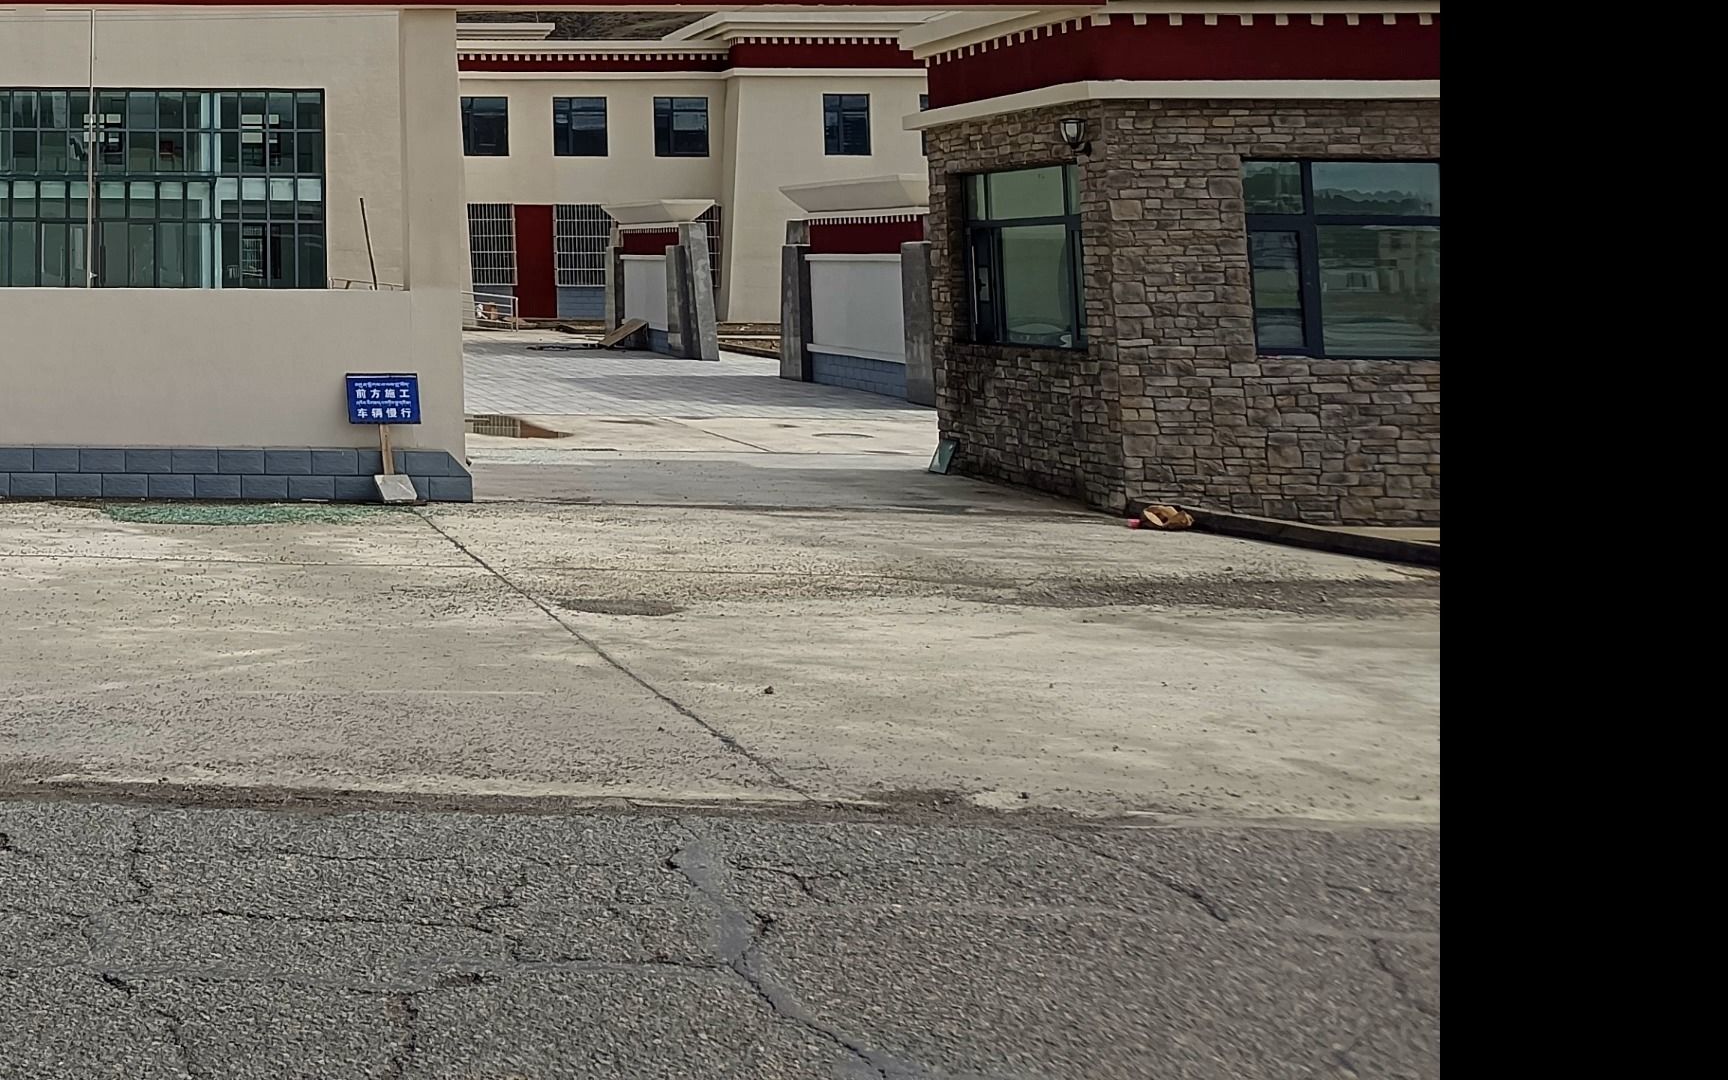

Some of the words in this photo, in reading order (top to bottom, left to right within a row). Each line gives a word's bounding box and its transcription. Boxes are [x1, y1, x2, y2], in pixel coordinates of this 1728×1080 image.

[355, 388, 410, 399] 前方施工
[357, 407, 412, 418] 车辆慢行
